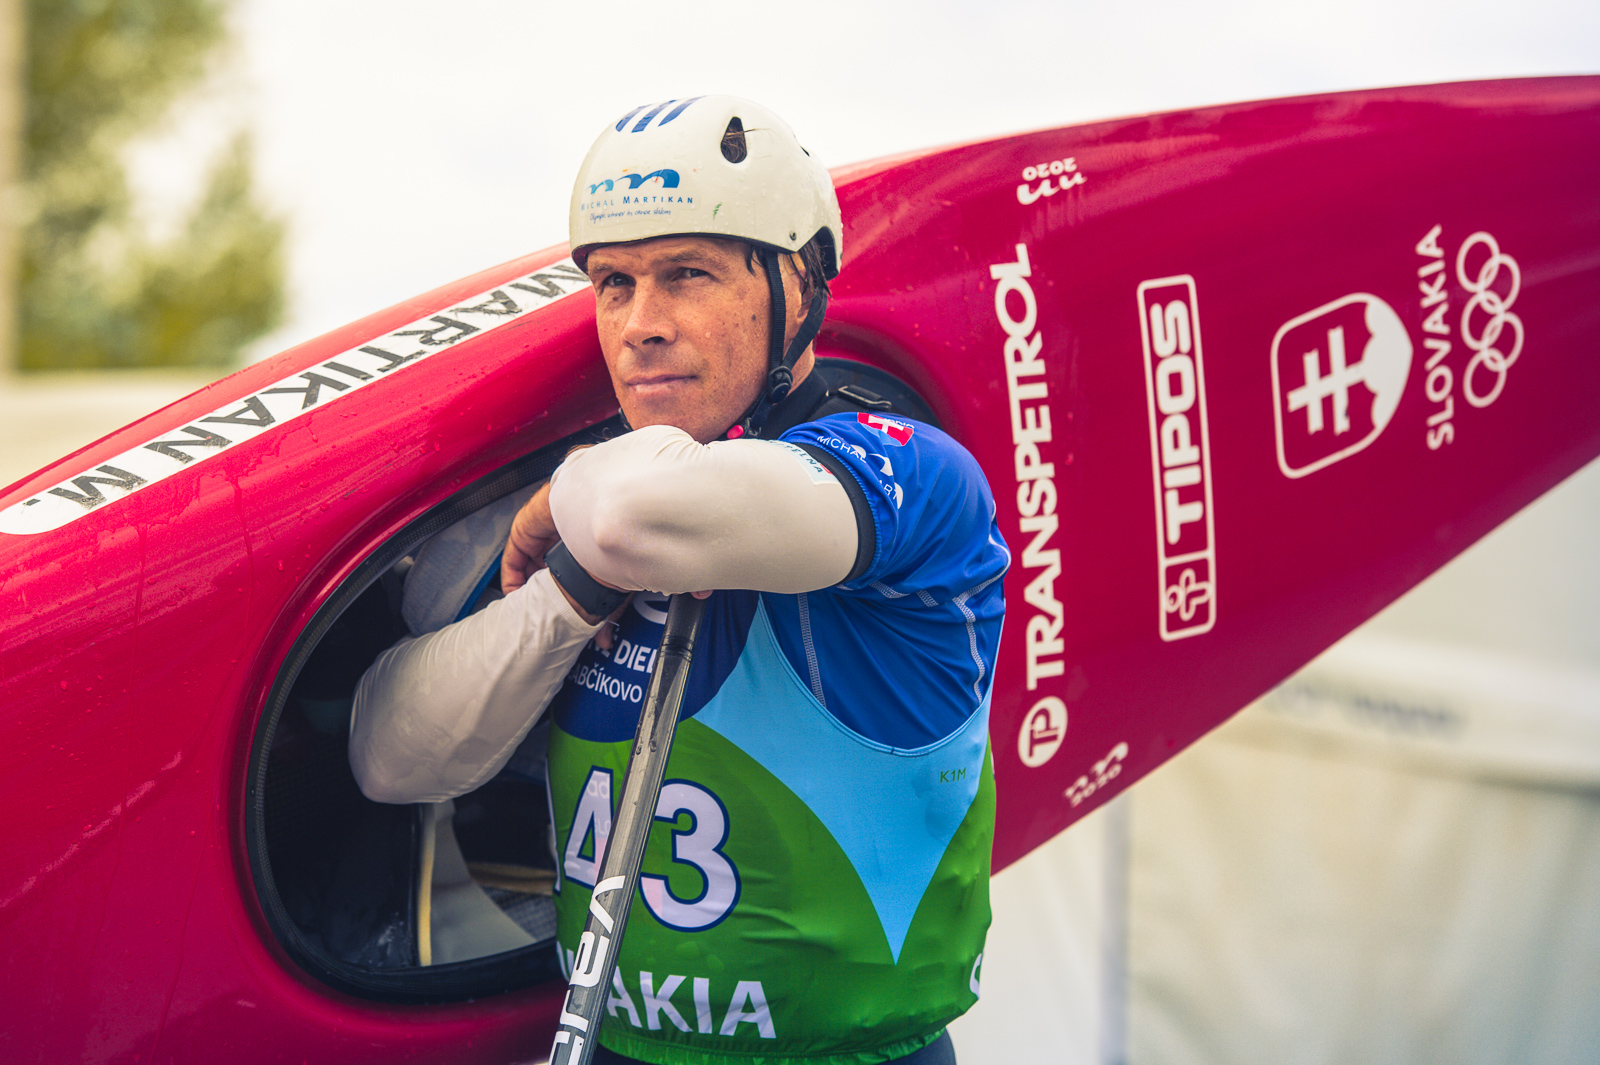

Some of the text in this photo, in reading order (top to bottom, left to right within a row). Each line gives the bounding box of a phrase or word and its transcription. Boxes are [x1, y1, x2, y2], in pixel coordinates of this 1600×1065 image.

[581, 196, 693, 211] MICHAL MARTIKAN
[1022, 157, 1077, 181] 2020
[145, 264, 590, 465] MARTIKAN
[1150, 299, 1204, 545] TIPOS
[1415, 223, 1455, 450] SLOVAKIA
[989, 242, 1065, 691] TRANSPETROL
[939, 767, 967, 784] K1M
